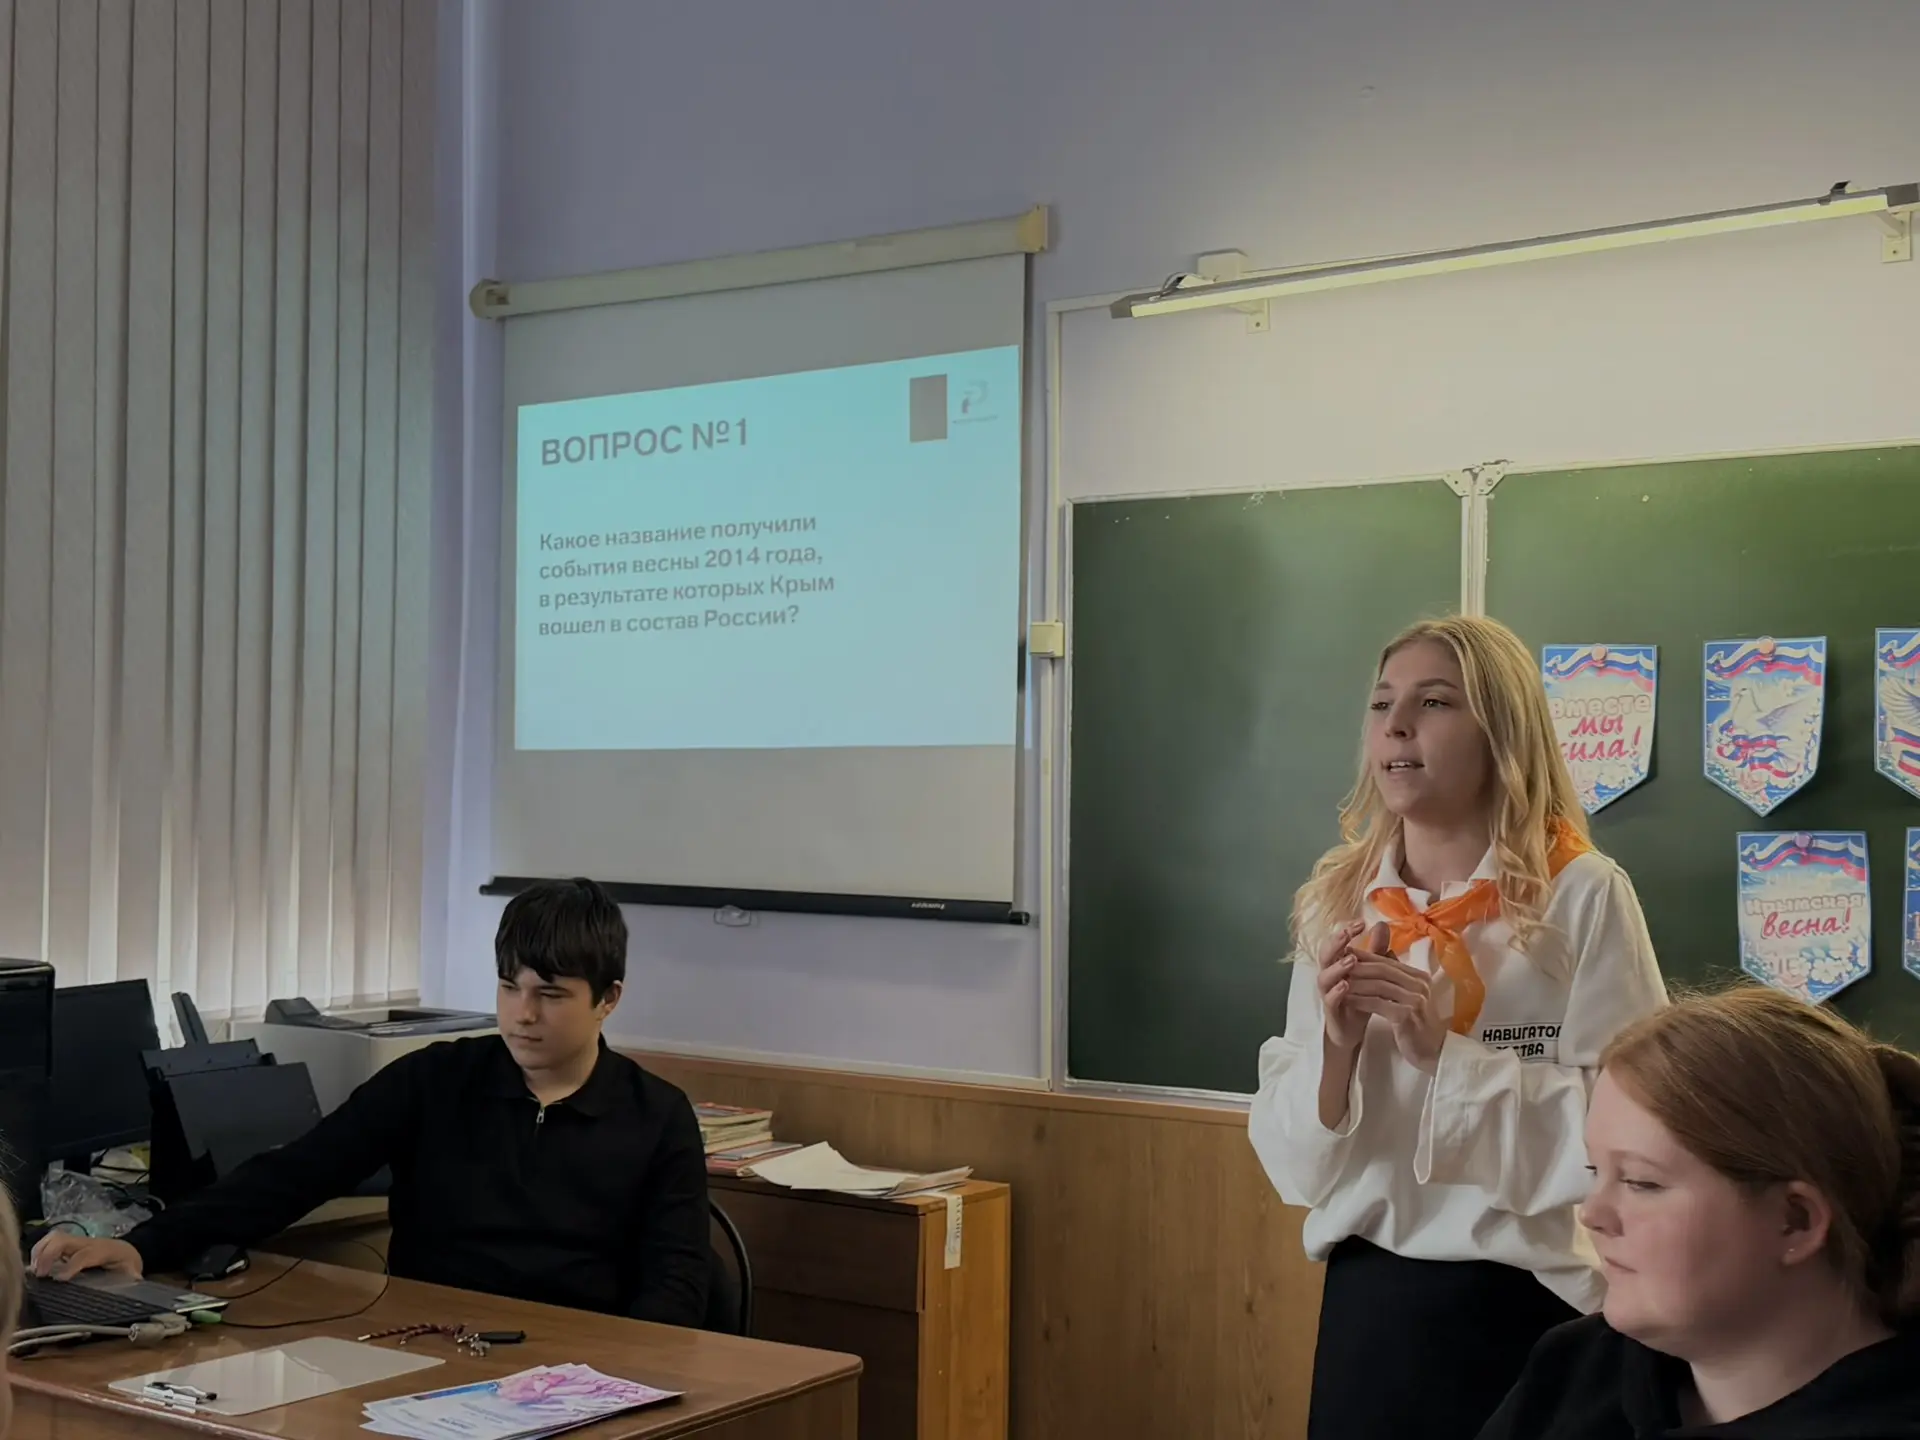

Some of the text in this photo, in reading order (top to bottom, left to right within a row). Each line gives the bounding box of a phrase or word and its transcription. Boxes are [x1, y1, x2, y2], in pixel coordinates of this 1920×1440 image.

[541, 417, 747, 466] ВОПРОС №1
[539, 516, 817, 551] Какое название получили
[539, 546, 824, 580] события весны 2014 года,
[539, 573, 835, 611] в результате которых Крым
[539, 604, 799, 636] вошел в состав России?
[1549, 694, 1652, 720] Вместе
[1569, 713, 1625, 737] мы
[1761, 906, 1852, 939] весна!
